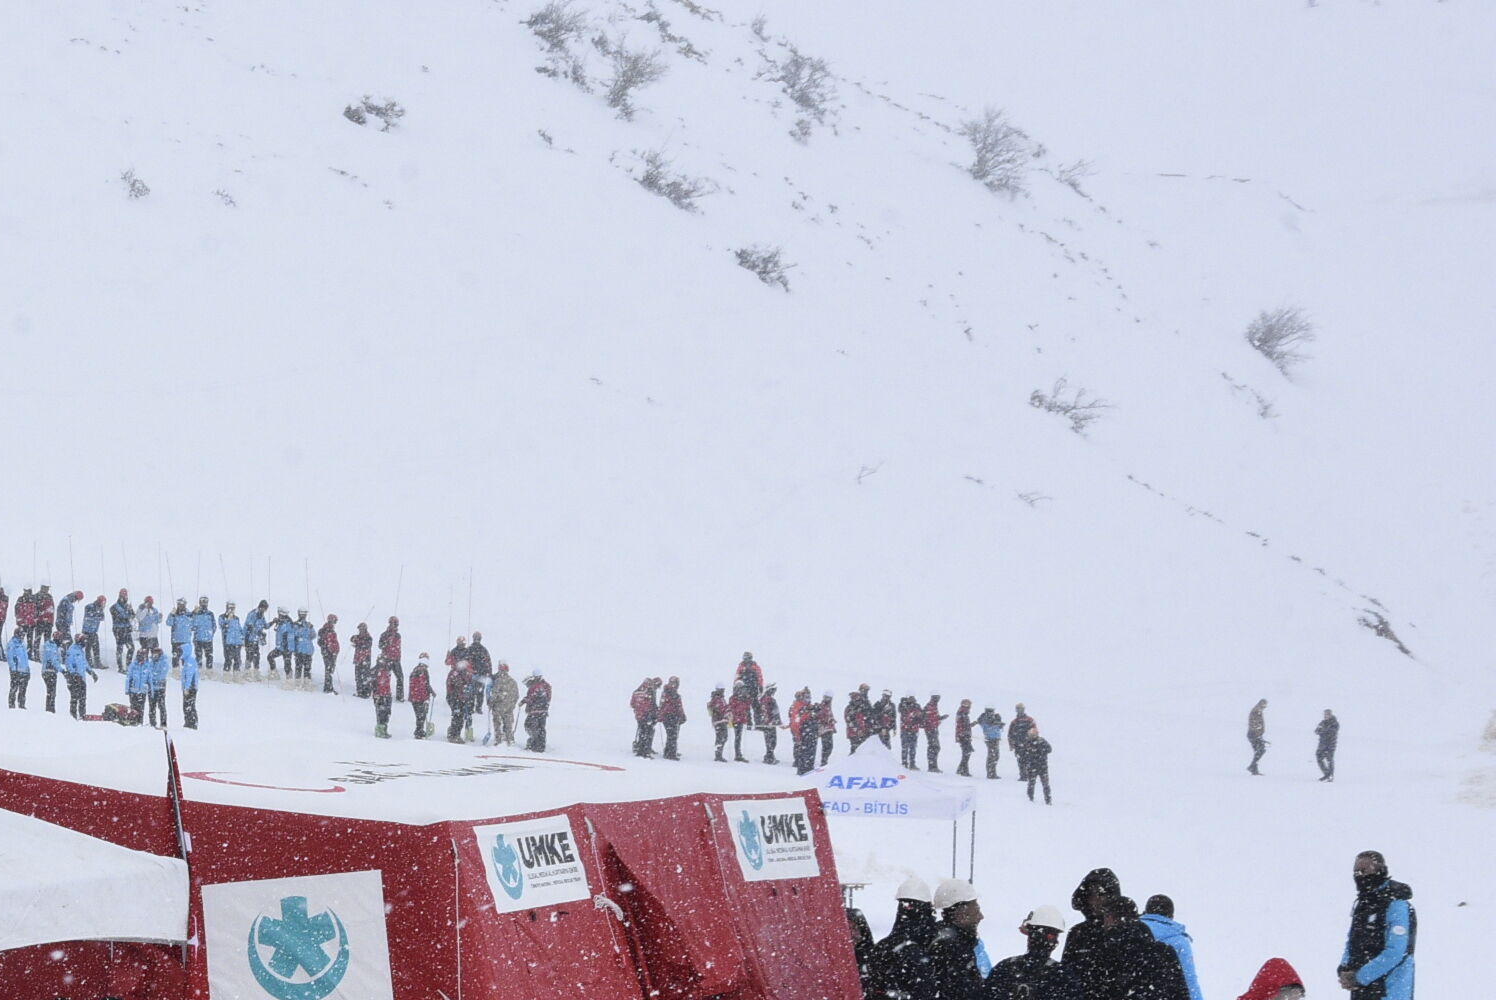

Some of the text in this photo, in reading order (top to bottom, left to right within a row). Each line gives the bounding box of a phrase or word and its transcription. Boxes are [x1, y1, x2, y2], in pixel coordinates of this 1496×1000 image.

[826, 775, 899, 790] AFAD
[823, 801, 852, 814] FAD
[864, 800, 908, 815] BİTLİS
[760, 813, 809, 845] UMKE
[516, 832, 576, 869] UMKE
